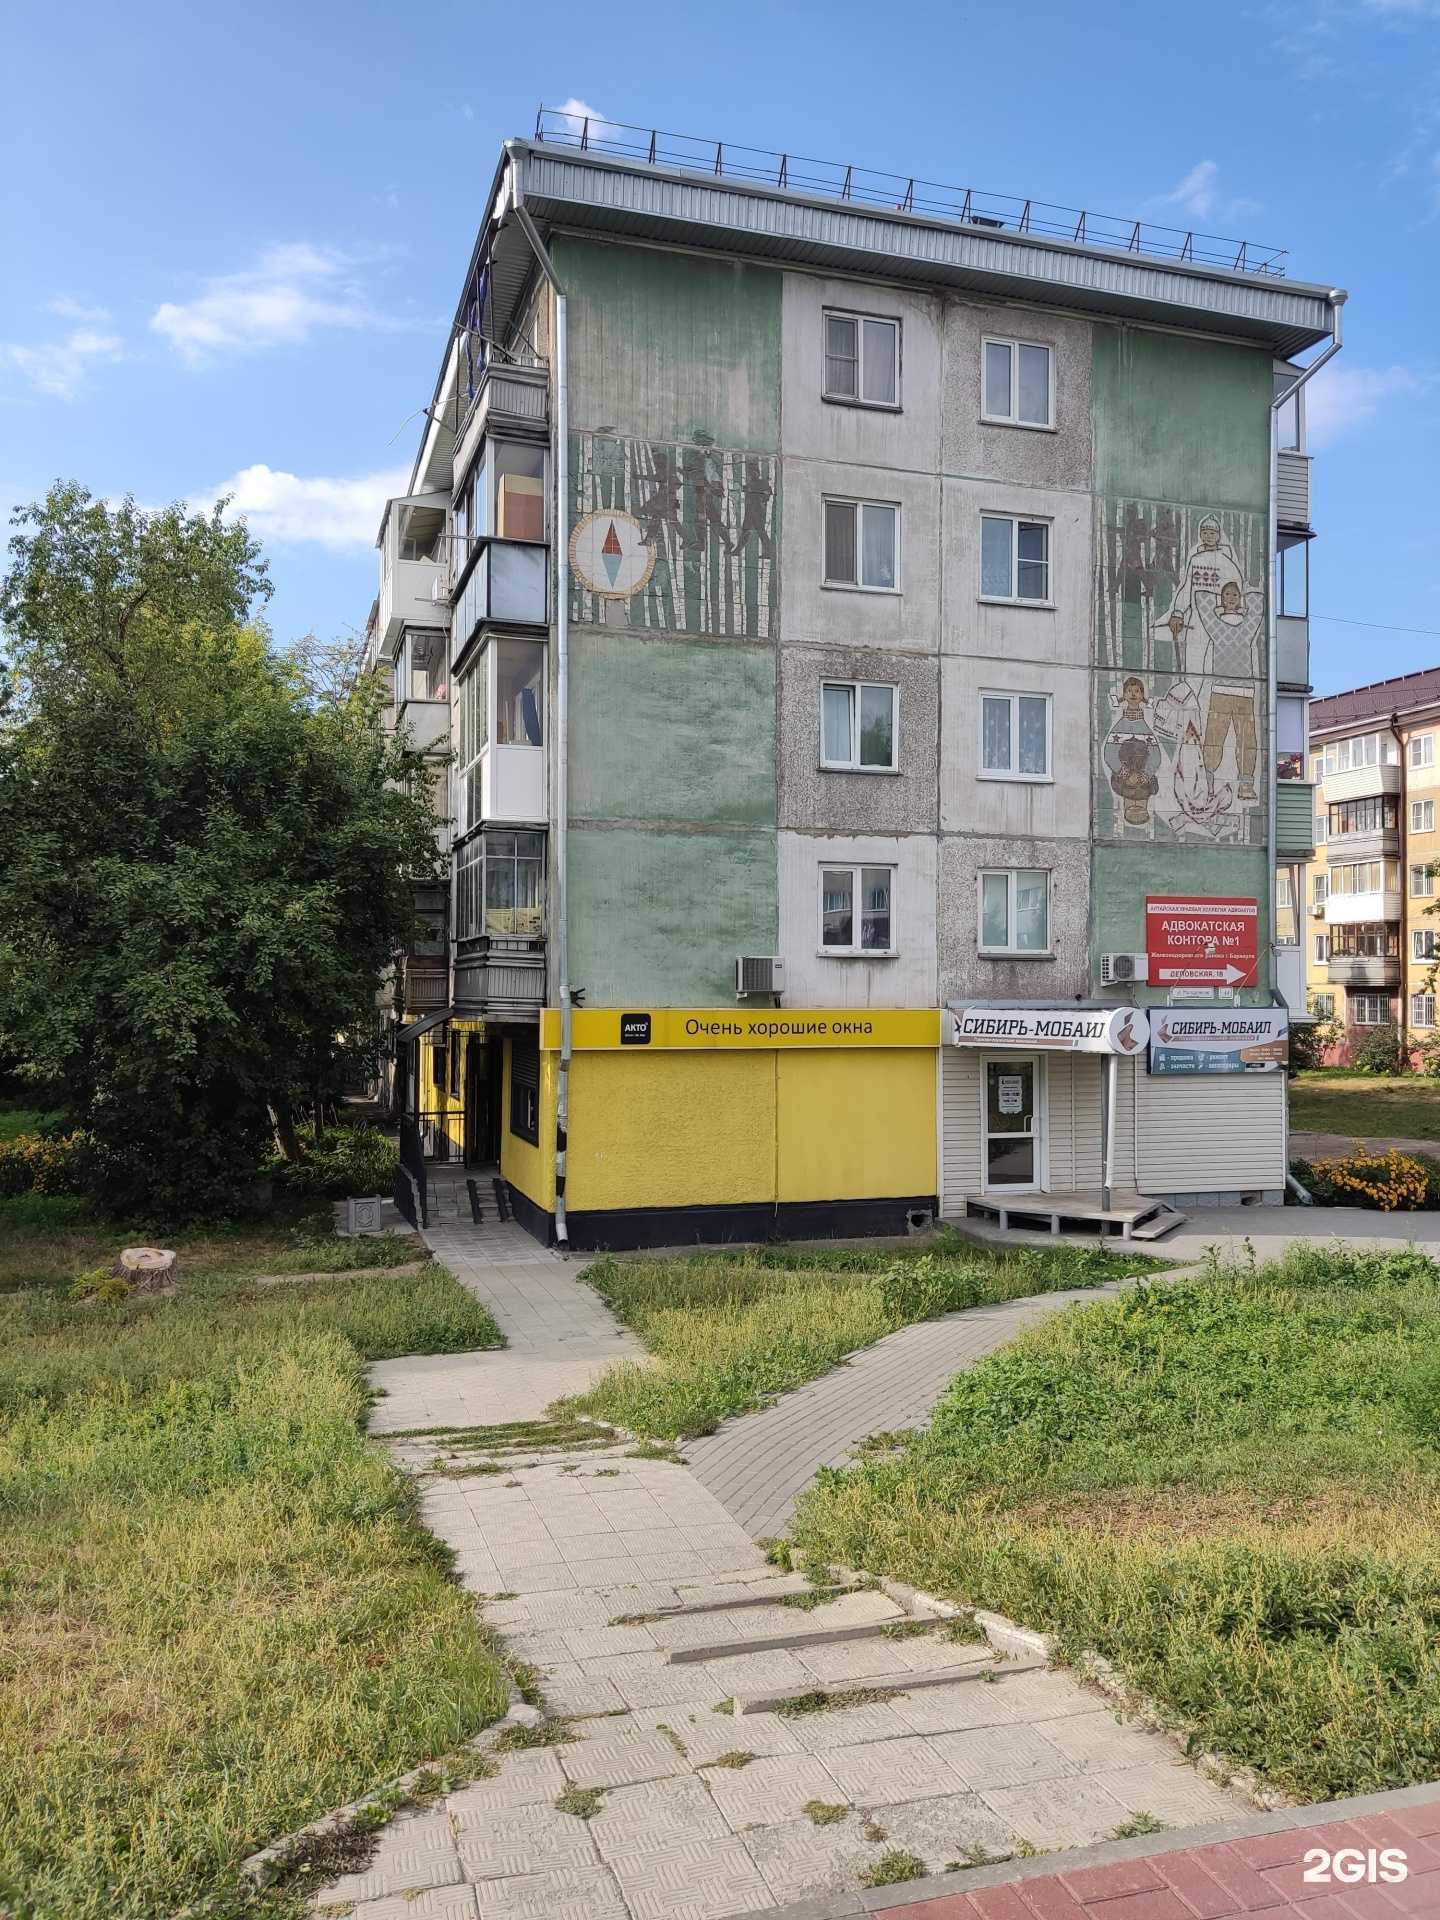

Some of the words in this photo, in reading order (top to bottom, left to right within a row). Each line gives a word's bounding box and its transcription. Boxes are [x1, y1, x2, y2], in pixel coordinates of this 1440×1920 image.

[1161, 920, 1245, 933] АДВОКАТСКАЯ
[1167, 935, 1219, 946] КОНТОРА
[685, 1019, 743, 1035] Очень
[748, 1022, 827, 1038] хорошие
[832, 1022, 873, 1034] окна
